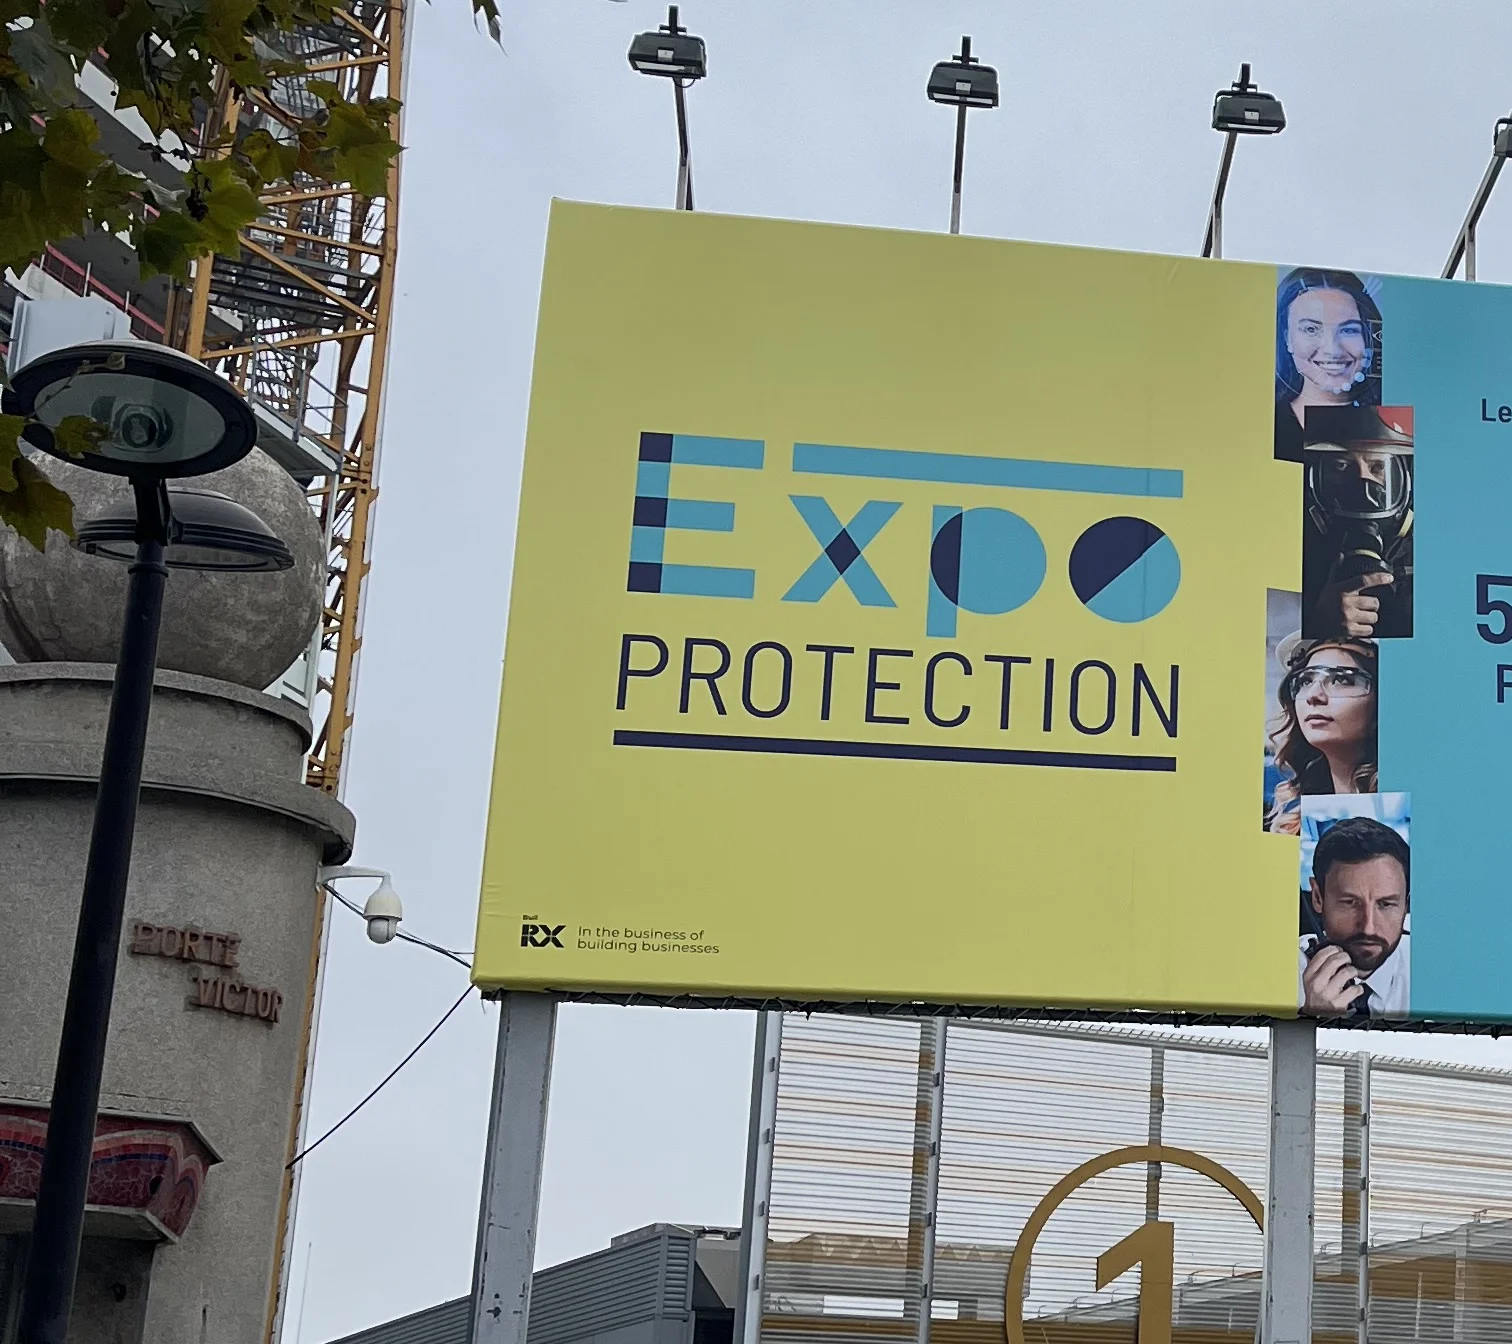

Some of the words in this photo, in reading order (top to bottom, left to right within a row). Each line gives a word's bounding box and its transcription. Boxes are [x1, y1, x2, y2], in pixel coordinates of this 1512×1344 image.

[1481, 398, 1512, 423] Le
[626, 431, 1184, 637] Expo
[615, 633, 1180, 739] PROTECTION
[133, 923, 240, 968] PORTE
[520, 923, 567, 949] RX
[578, 925, 592, 937] In
[596, 927, 620, 938] the
[623, 927, 687, 941] business
[689, 929, 705, 941] of
[577, 938, 637, 954] building
[641, 940, 720, 954] businesses
[195, 976, 284, 1023] VICTOR
